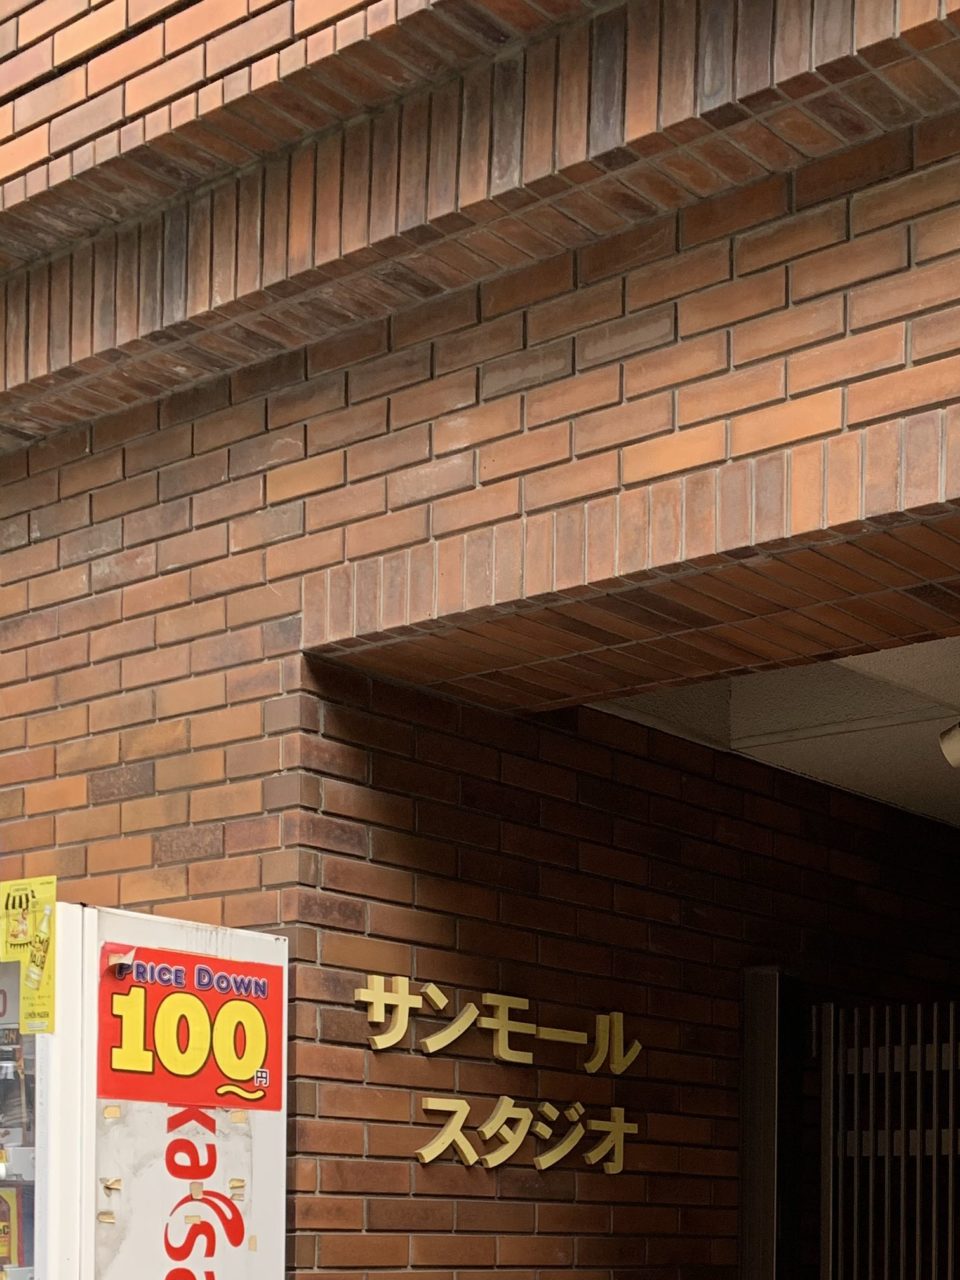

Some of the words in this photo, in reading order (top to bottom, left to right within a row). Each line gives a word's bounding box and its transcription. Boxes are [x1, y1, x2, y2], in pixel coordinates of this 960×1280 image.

[195, 964, 268, 998] DOWN
[354, 974, 642, 1074] サンモール
[414, 1095, 638, 1175] スタジオ
